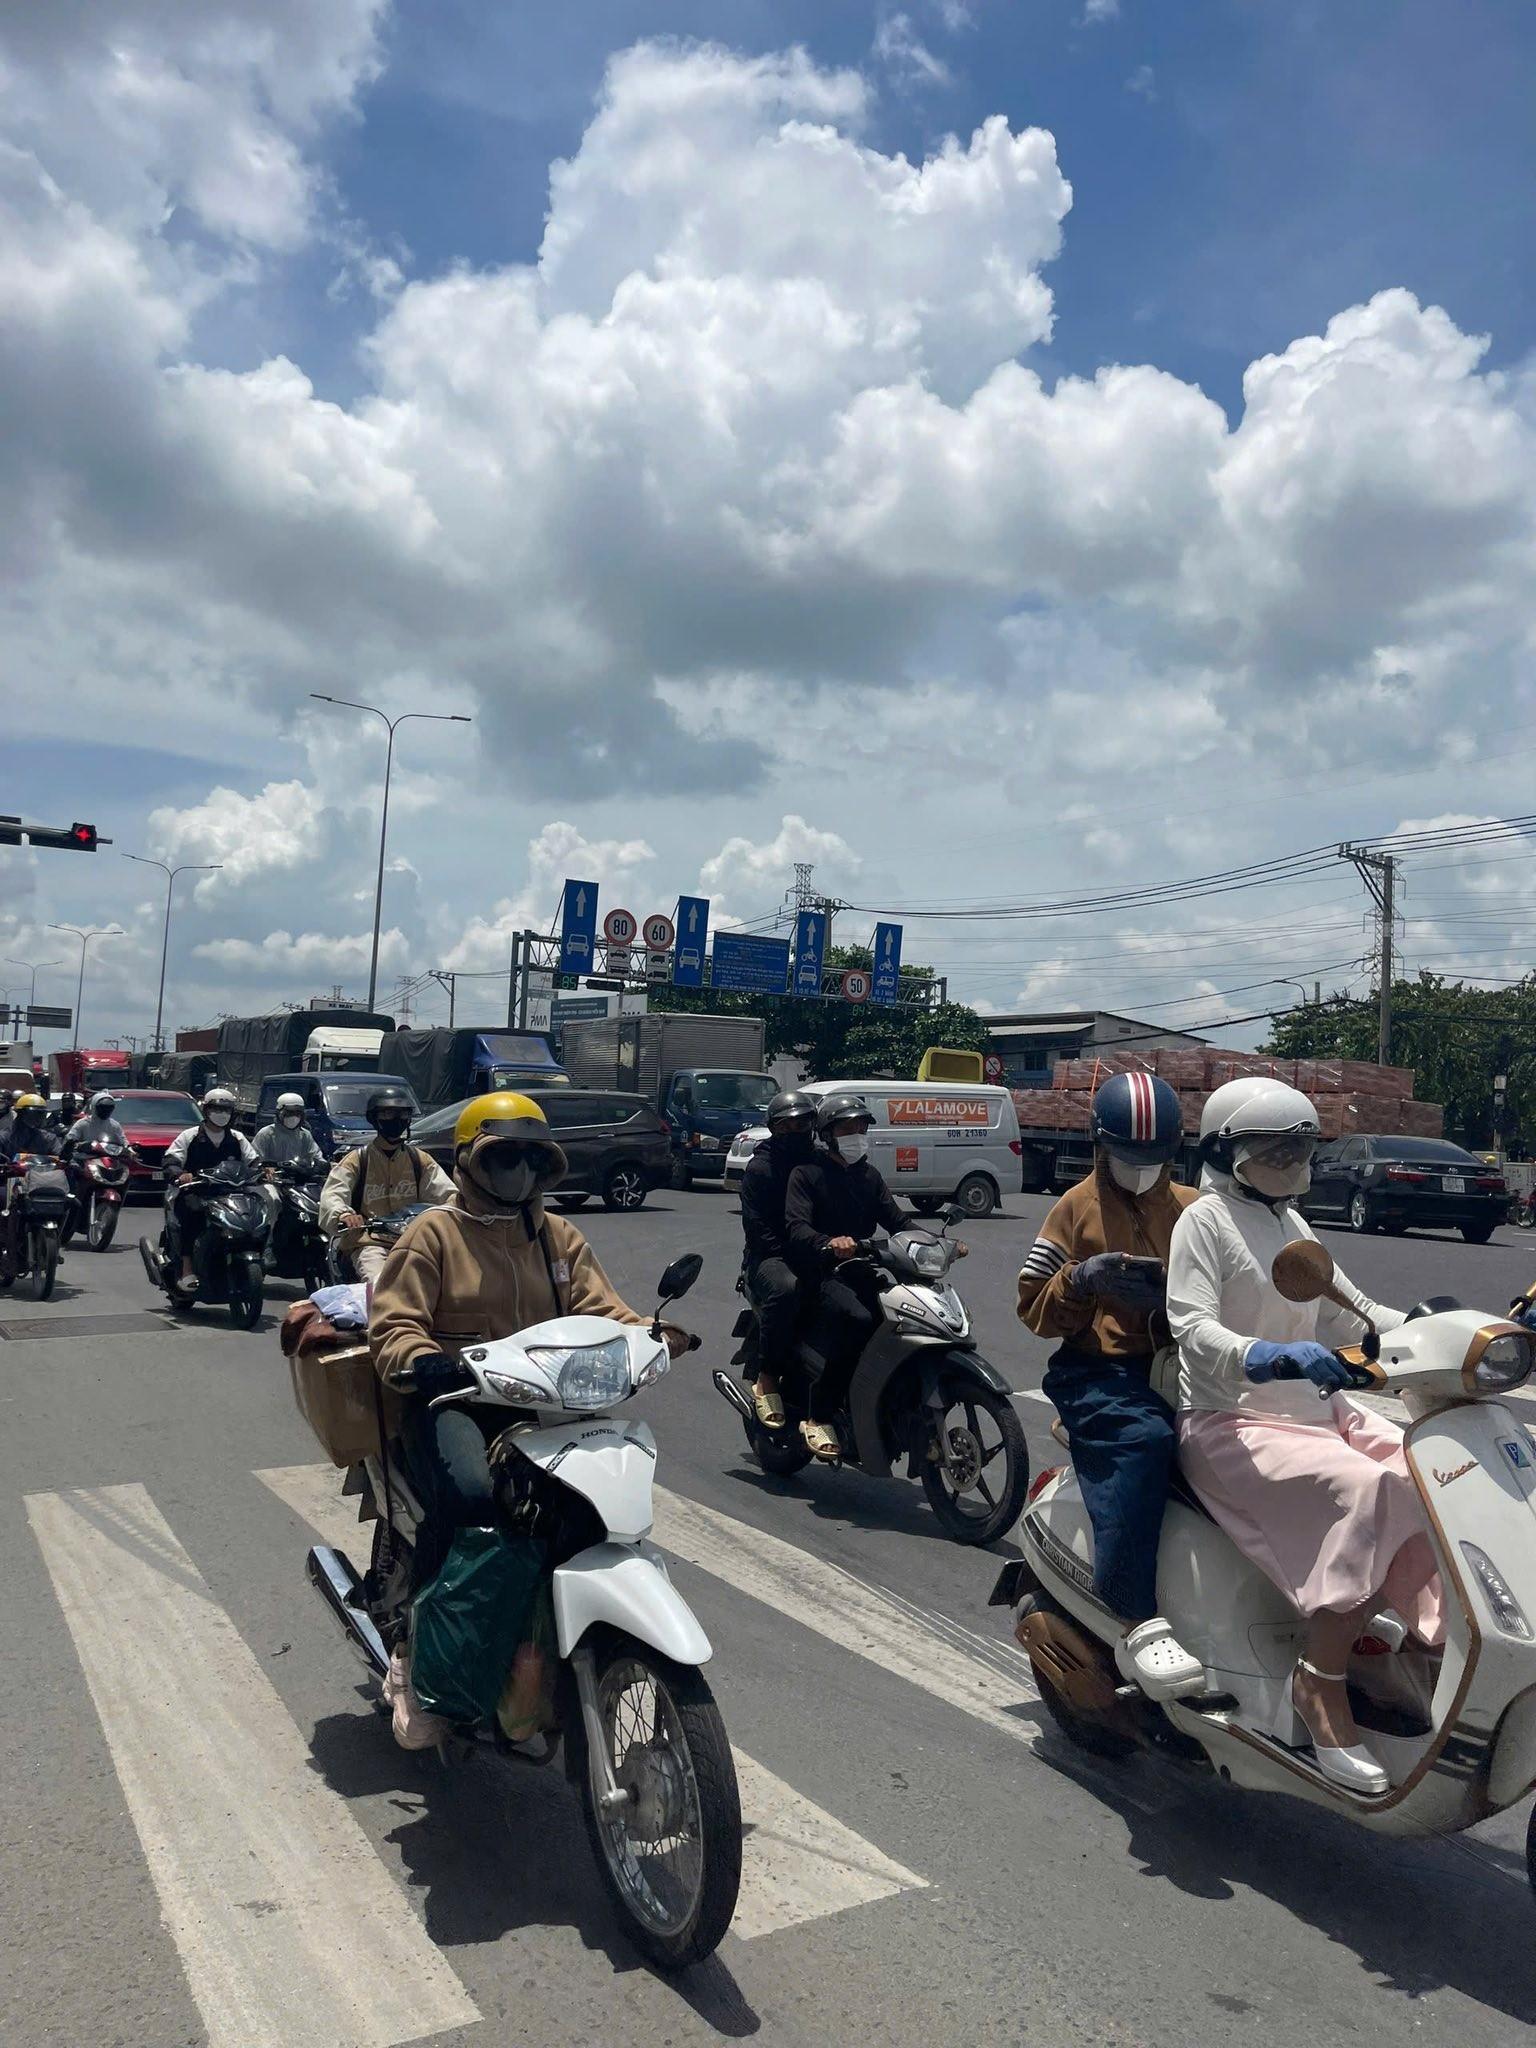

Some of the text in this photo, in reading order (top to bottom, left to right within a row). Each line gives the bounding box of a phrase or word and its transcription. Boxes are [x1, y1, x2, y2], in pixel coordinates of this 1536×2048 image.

[613, 918, 628, 936] 80
[652, 924, 666, 941] 60
[561, 975, 577, 990] 85
[850, 978, 863, 993] 50
[906, 1101, 986, 1115] LALAMOVE
[580, 1428, 619, 1439] HONDA
[1042, 1538, 1093, 1591] CHRISTIAN DIOR
